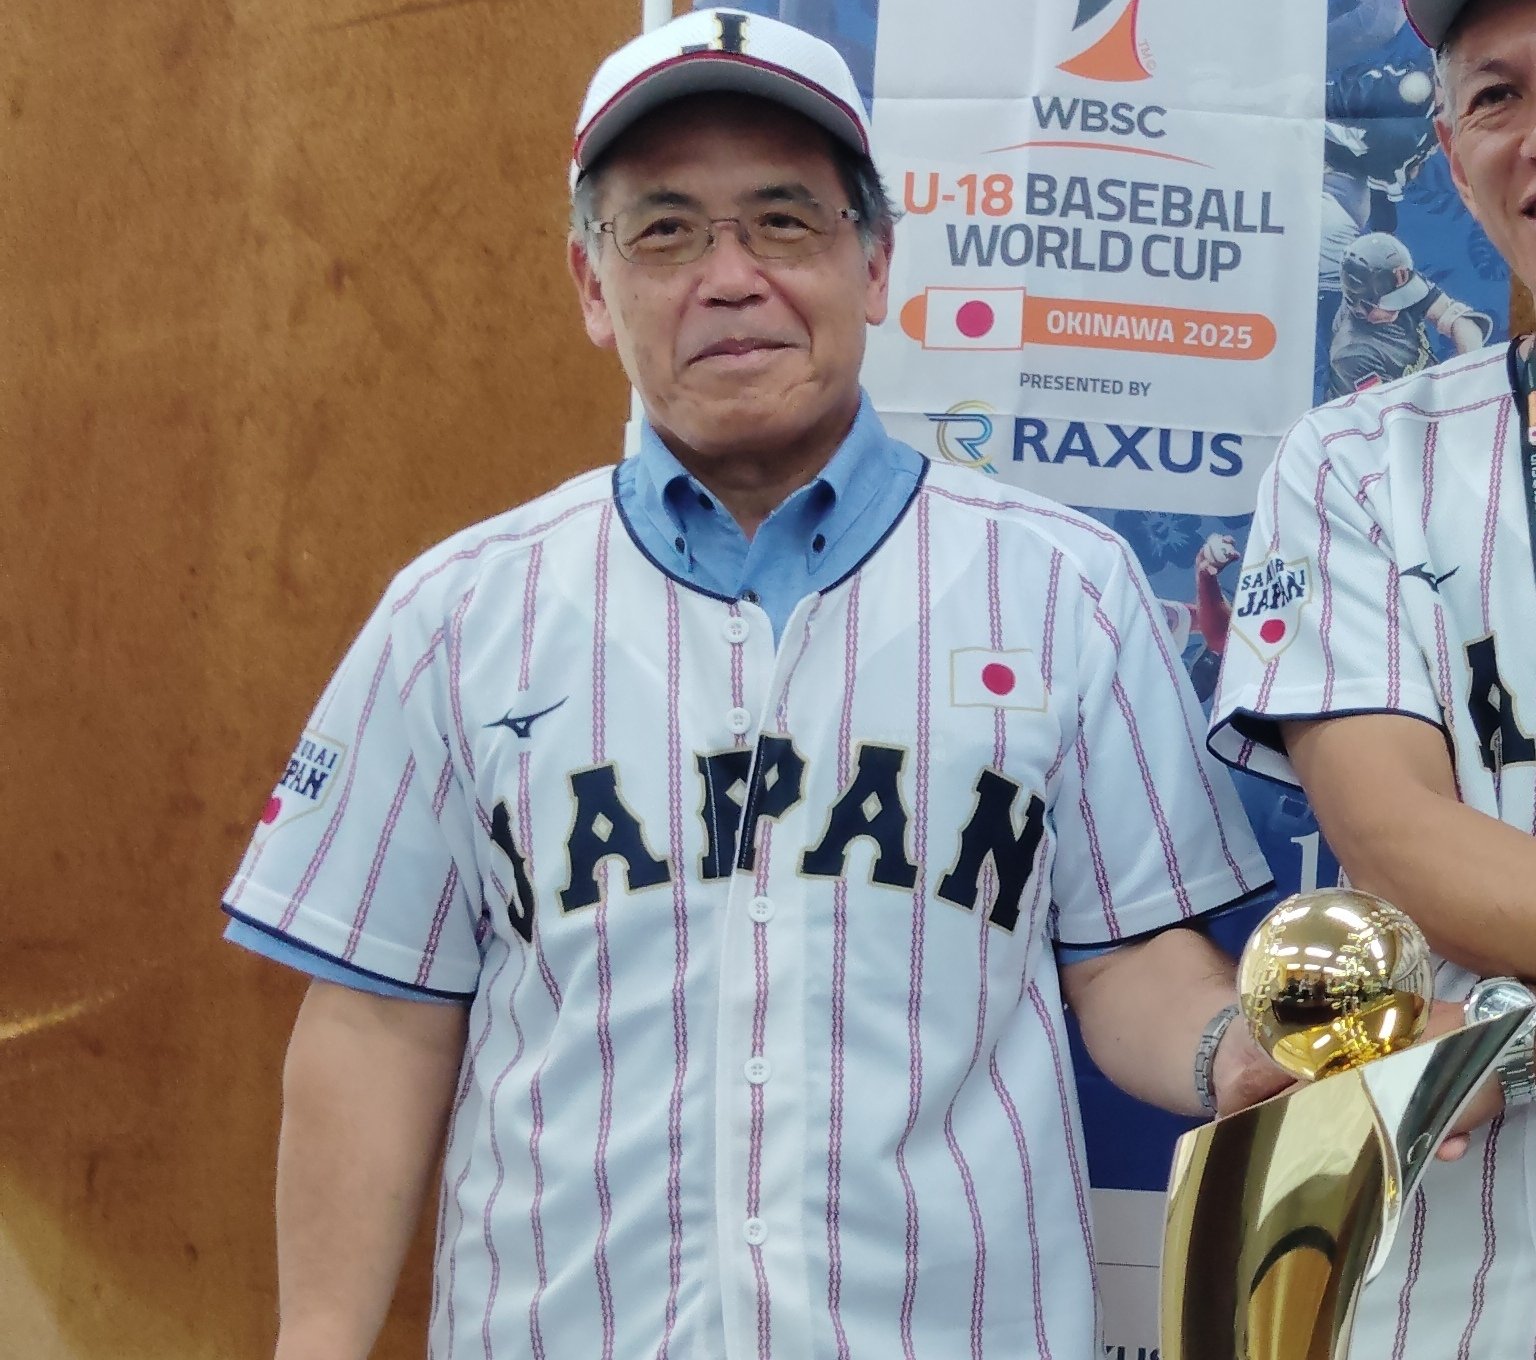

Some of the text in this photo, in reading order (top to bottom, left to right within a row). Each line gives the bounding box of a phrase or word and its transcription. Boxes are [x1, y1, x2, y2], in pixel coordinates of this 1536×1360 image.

[1032, 96, 1167, 139] WBSC
[903, 171, 1285, 235] U-18 BASEBALL
[945, 223, 1242, 283] WORLD CUP
[1046, 309, 1253, 350] OKINAWA 2025
[1019, 371, 1152, 397] PRESENTED BY
[1012, 416, 1244, 478] RAXUS
[279, 758, 329, 800] PAN
